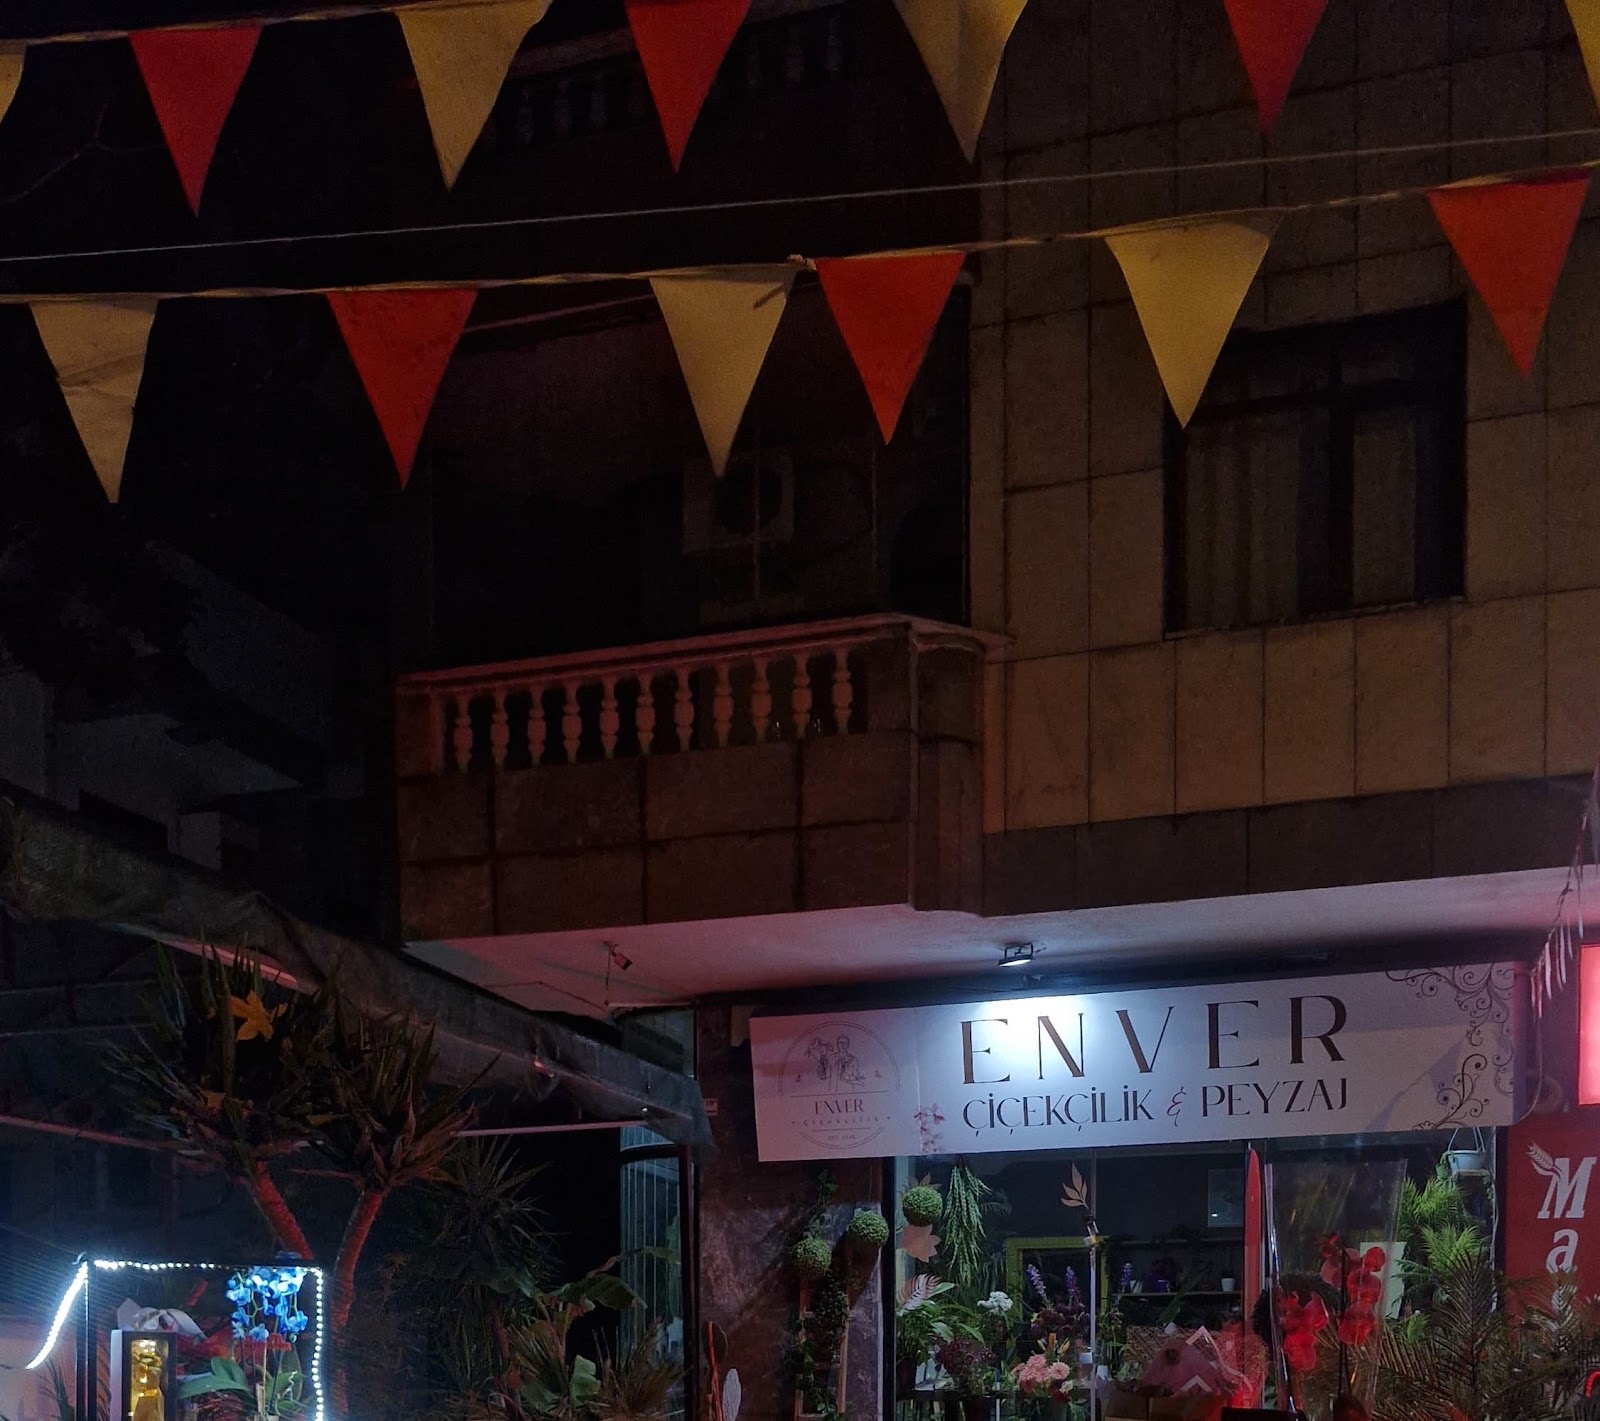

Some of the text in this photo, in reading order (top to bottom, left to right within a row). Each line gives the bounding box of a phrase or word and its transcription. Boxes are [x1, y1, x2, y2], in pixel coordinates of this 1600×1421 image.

[961, 995, 1346, 1084] ENVER
[815, 1098, 864, 1115] ENVER
[963, 1078, 1348, 1137] ÇİÇEKÇİLİK & PEYZAJ
